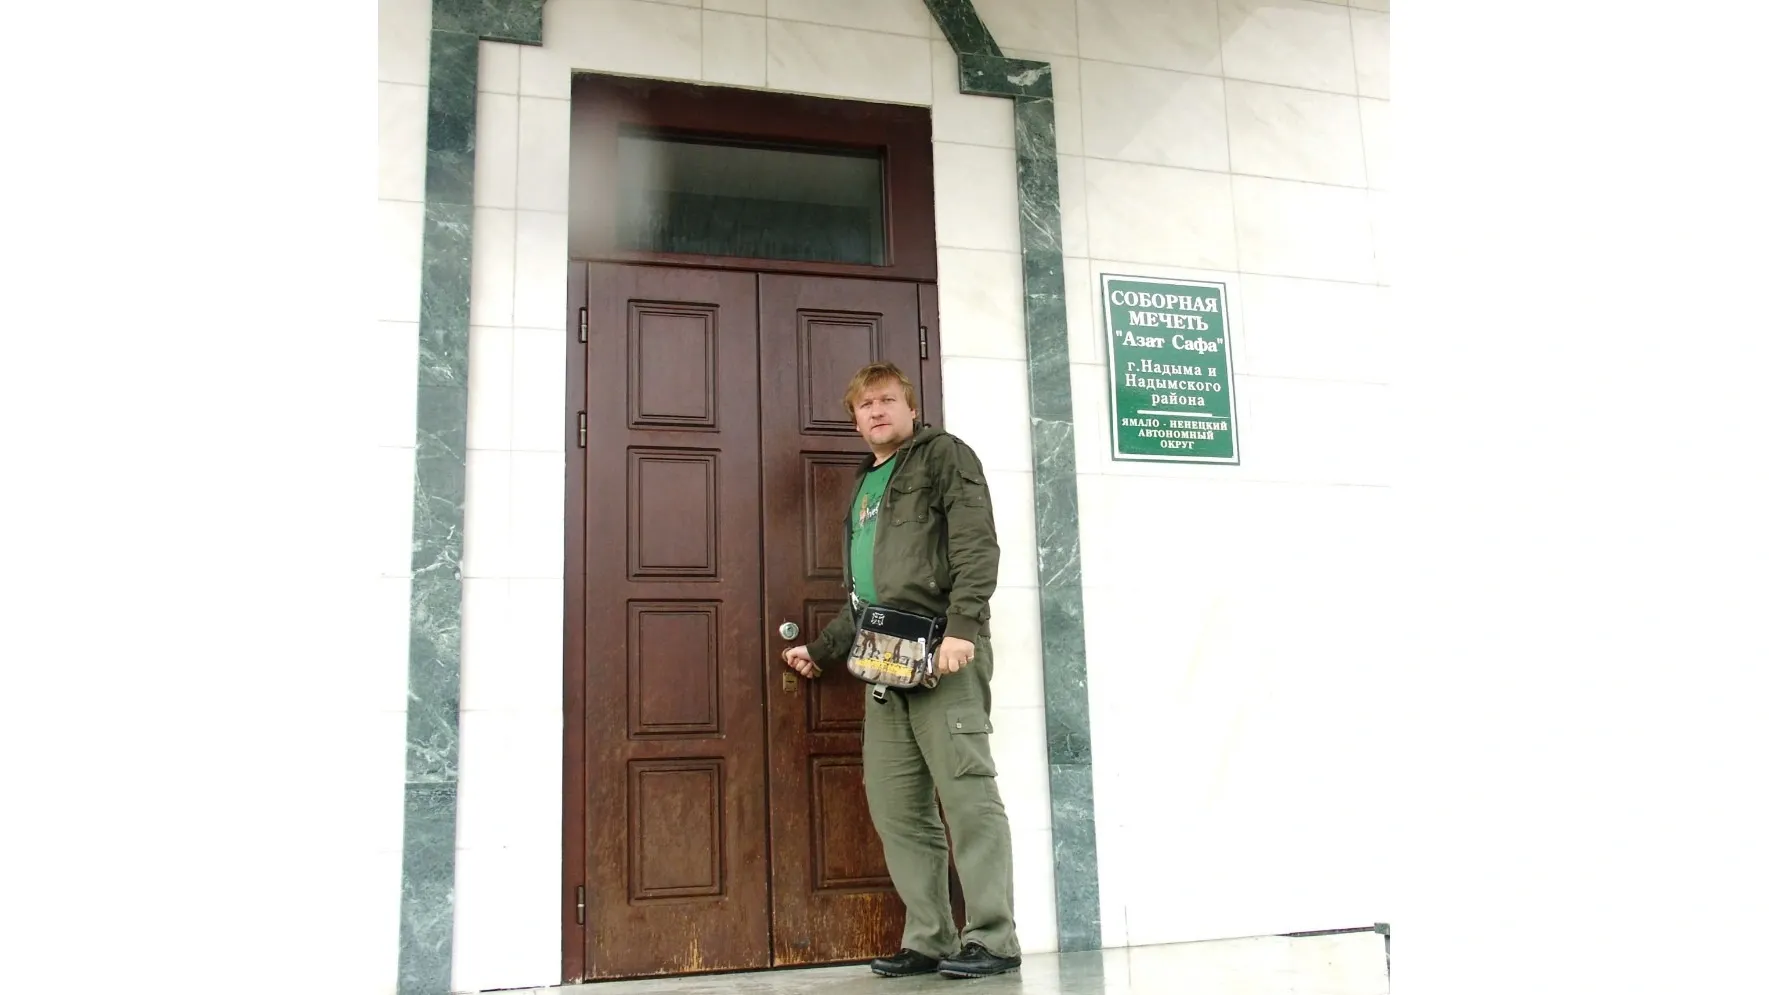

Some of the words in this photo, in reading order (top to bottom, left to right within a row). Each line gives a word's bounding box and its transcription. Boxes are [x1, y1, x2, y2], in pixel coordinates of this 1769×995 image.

[1111, 290, 1219, 313] СОБОРНАЯ
[1128, 310, 1209, 331] МЕЧЕТЬ
[1115, 329, 1165, 349] "Азат
[1172, 334, 1224, 355] Сафа"
[1127, 359, 1203, 376] г.Надыма
[1208, 367, 1217, 377] и
[1125, 373, 1222, 392] Надымского
[1151, 392, 1205, 407] района
[1121, 418, 1160, 427] ЯМАЛО
[1170, 420, 1228, 431] НЕНЕЦКИЙ
[1138, 429, 1214, 440] АВТОНОМНЫЙ
[1160, 440, 1195, 449] ОКРУГ
